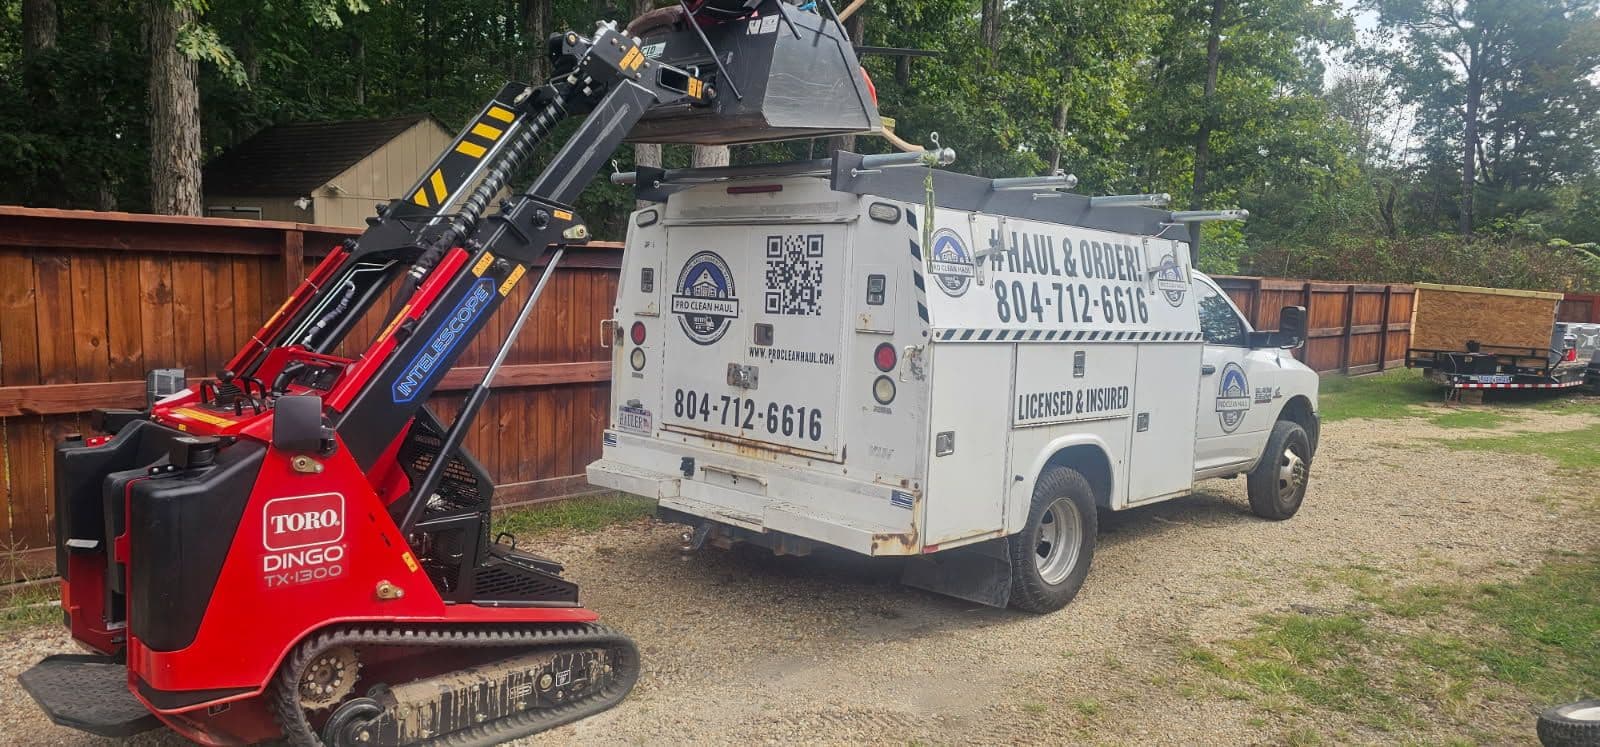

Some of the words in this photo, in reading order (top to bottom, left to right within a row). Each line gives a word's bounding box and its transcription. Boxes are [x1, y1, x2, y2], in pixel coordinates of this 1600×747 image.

[1062, 237, 1078, 277] &
[1080, 240, 1143, 282] ORDER!
[675, 300, 689, 309] PRO
[691, 301, 712, 311] CLEAN
[714, 303, 733, 313] HAUL
[994, 279, 1149, 324] 804-712-6616
[398, 284, 488, 396] INTELESCOPE
[674, 388, 822, 441] 804-712-6616
[1018, 390, 1073, 420] LICENSED
[1075, 389, 1083, 414] &
[1086, 385, 1129, 412] INSURED
[271, 509, 337, 533] TORO
[263, 546, 344, 572] DINGO
